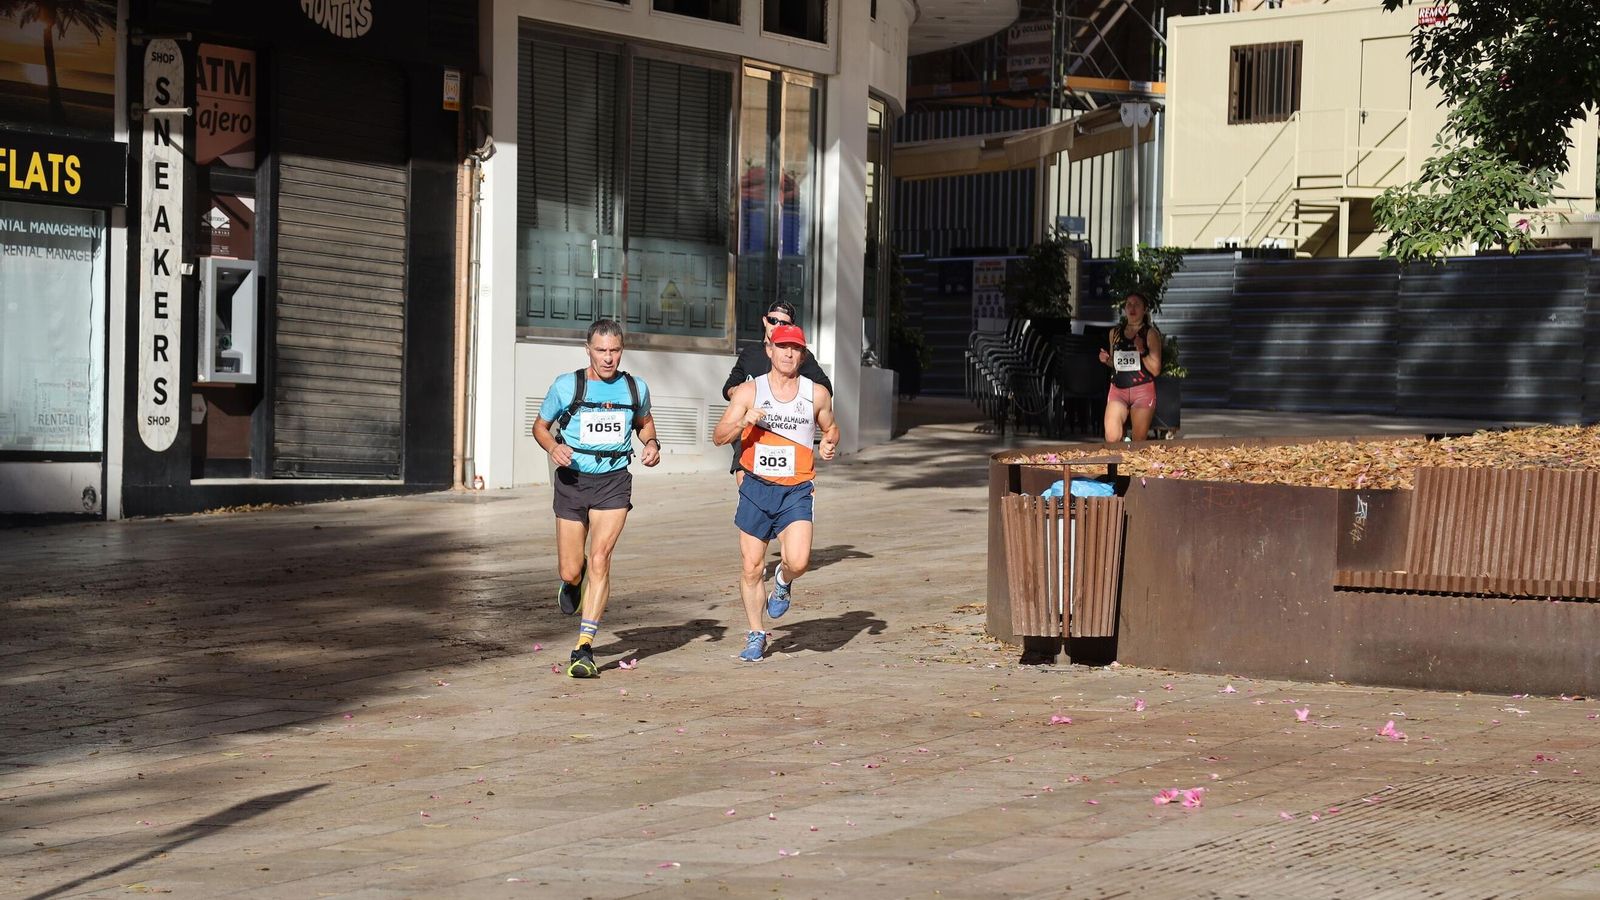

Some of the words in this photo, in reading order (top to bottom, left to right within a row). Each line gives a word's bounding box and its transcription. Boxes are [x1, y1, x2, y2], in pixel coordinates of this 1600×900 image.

[151, 52, 175, 64] SHOP
[197, 103, 251, 136] ajero
[30, 221, 101, 239] MANAGEMENT
[153, 77, 170, 405] SNEAKERS
[1117, 357, 1135, 365] 239
[147, 416, 170, 426] SHOP
[761, 412, 783, 422] ATLÓN
[586, 422, 621, 432] 1055
[759, 455, 787, 467] 303
